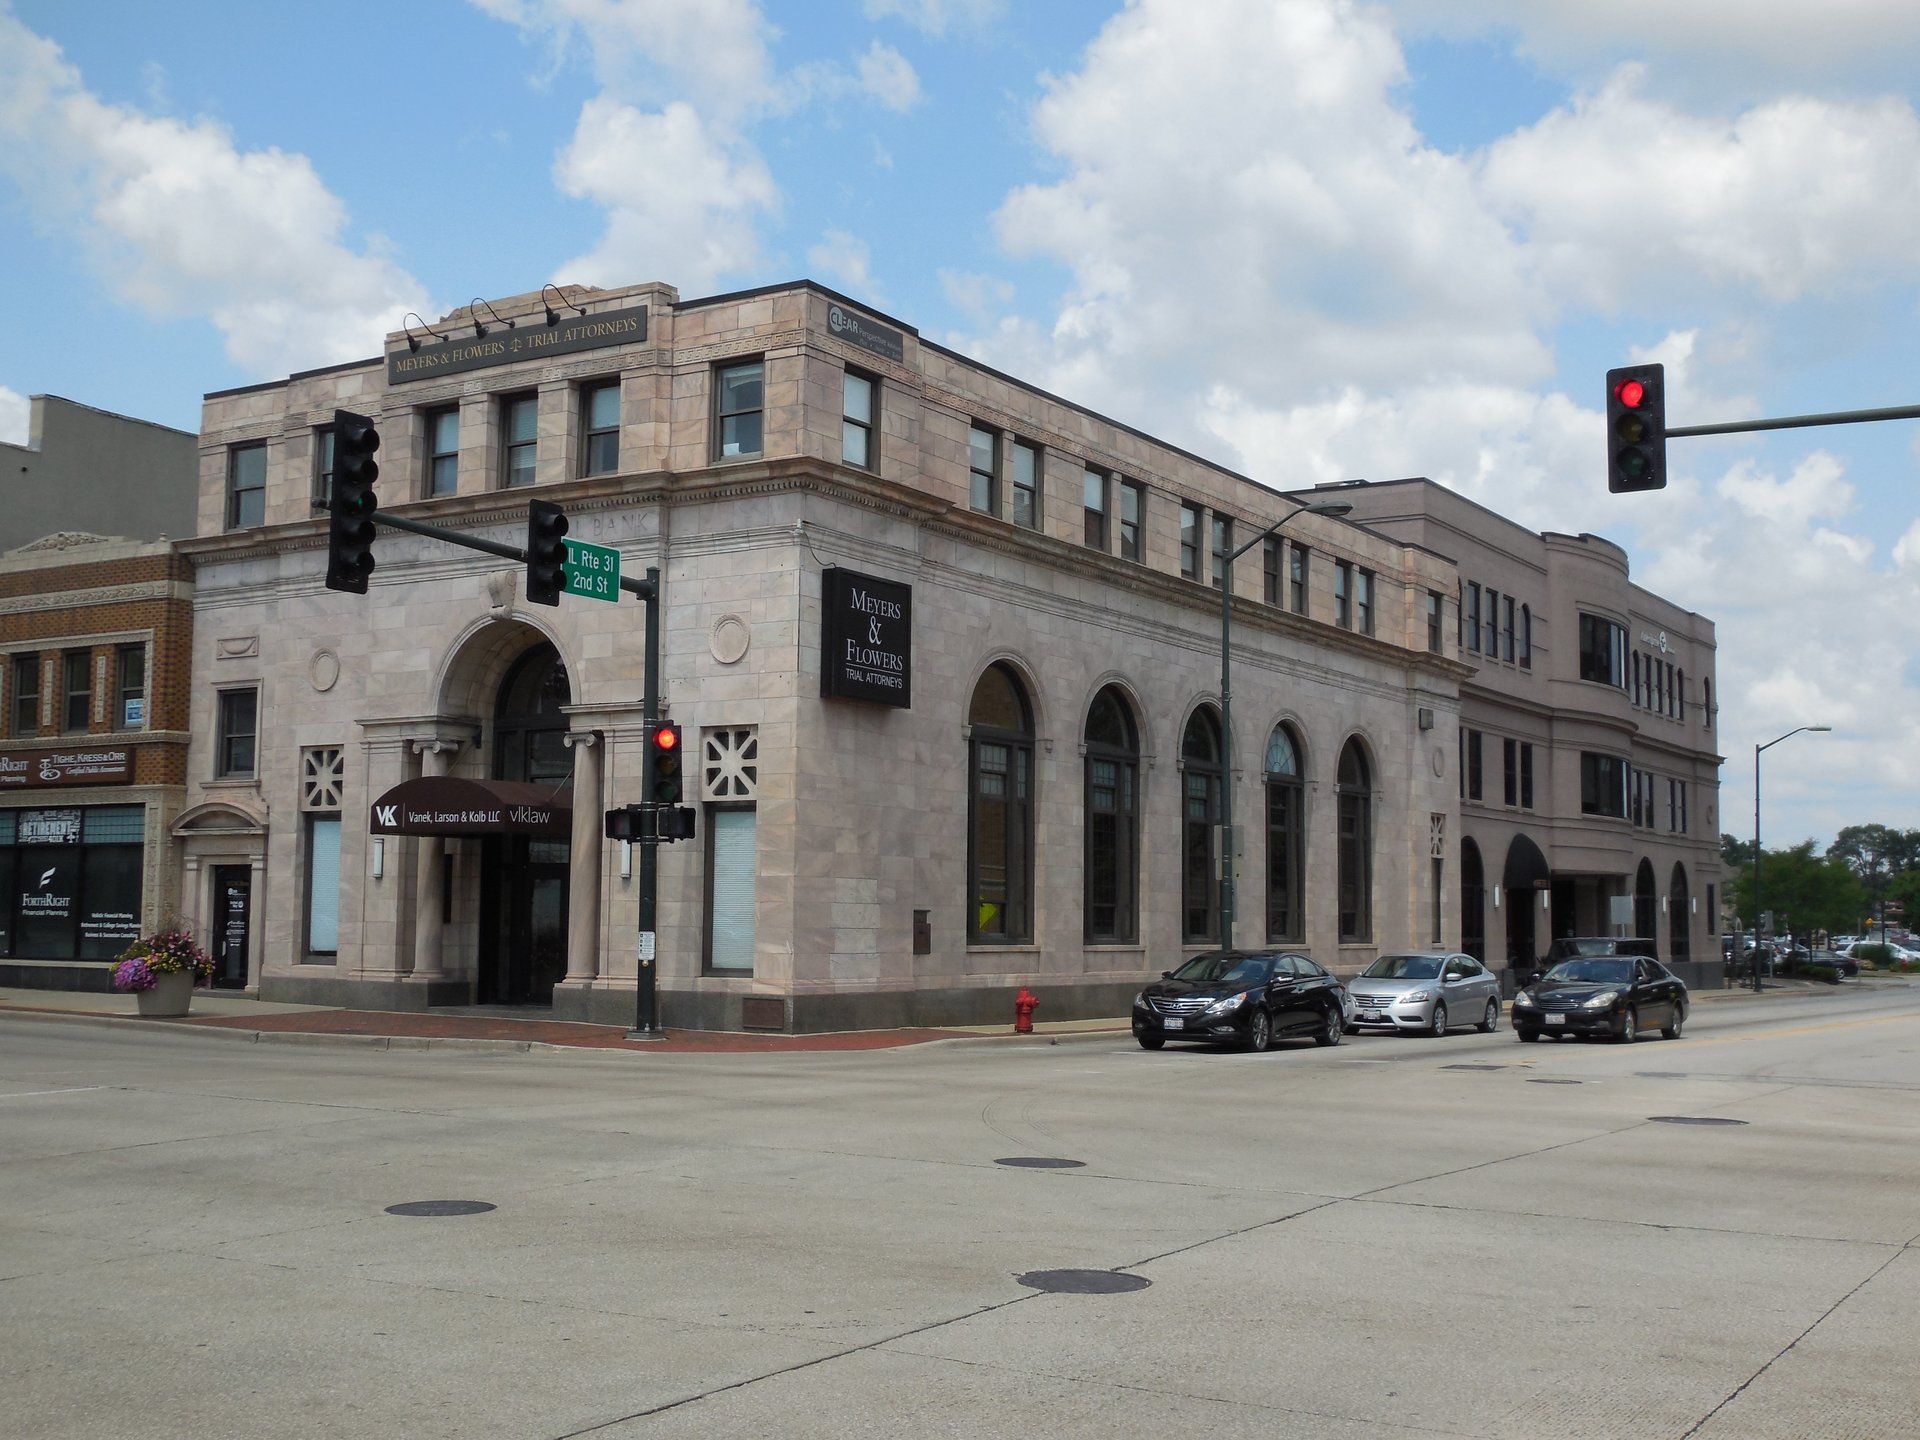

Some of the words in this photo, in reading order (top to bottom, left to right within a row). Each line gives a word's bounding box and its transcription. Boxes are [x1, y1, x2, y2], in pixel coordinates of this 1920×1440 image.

[830, 308, 858, 333] CLEAR
[396, 352, 438, 373] MEYERS
[441, 351, 449, 364] &
[453, 341, 505, 362] FLOWERS
[526, 332, 559, 348] TRIAL
[564, 317, 637, 343] ATTORNEYS
[568, 547, 577, 565] IL
[581, 550, 600, 569] Rte
[603, 555, 614, 572] 31
[573, 571, 592, 590] 2nd
[596, 576, 608, 593] St
[851, 588, 901, 619] MEYERS
[868, 615, 882, 645] &
[846, 638, 903, 671] FLOWERS
[846, 668, 864, 682] TRIAL
[866, 672, 903, 689] ATTORNEYS
[0, 756, 29, 771] RIGHT
[108, 751, 126, 761] ORR
[409, 811, 433, 824] Vanek,
[434, 811, 459, 823] Larson
[461, 811, 468, 823] &
[469, 811, 486, 823] Kolb
[486, 811, 500, 823] LLC
[509, 805, 551, 824] vlklaw
[46, 909, 69, 917] Planning
